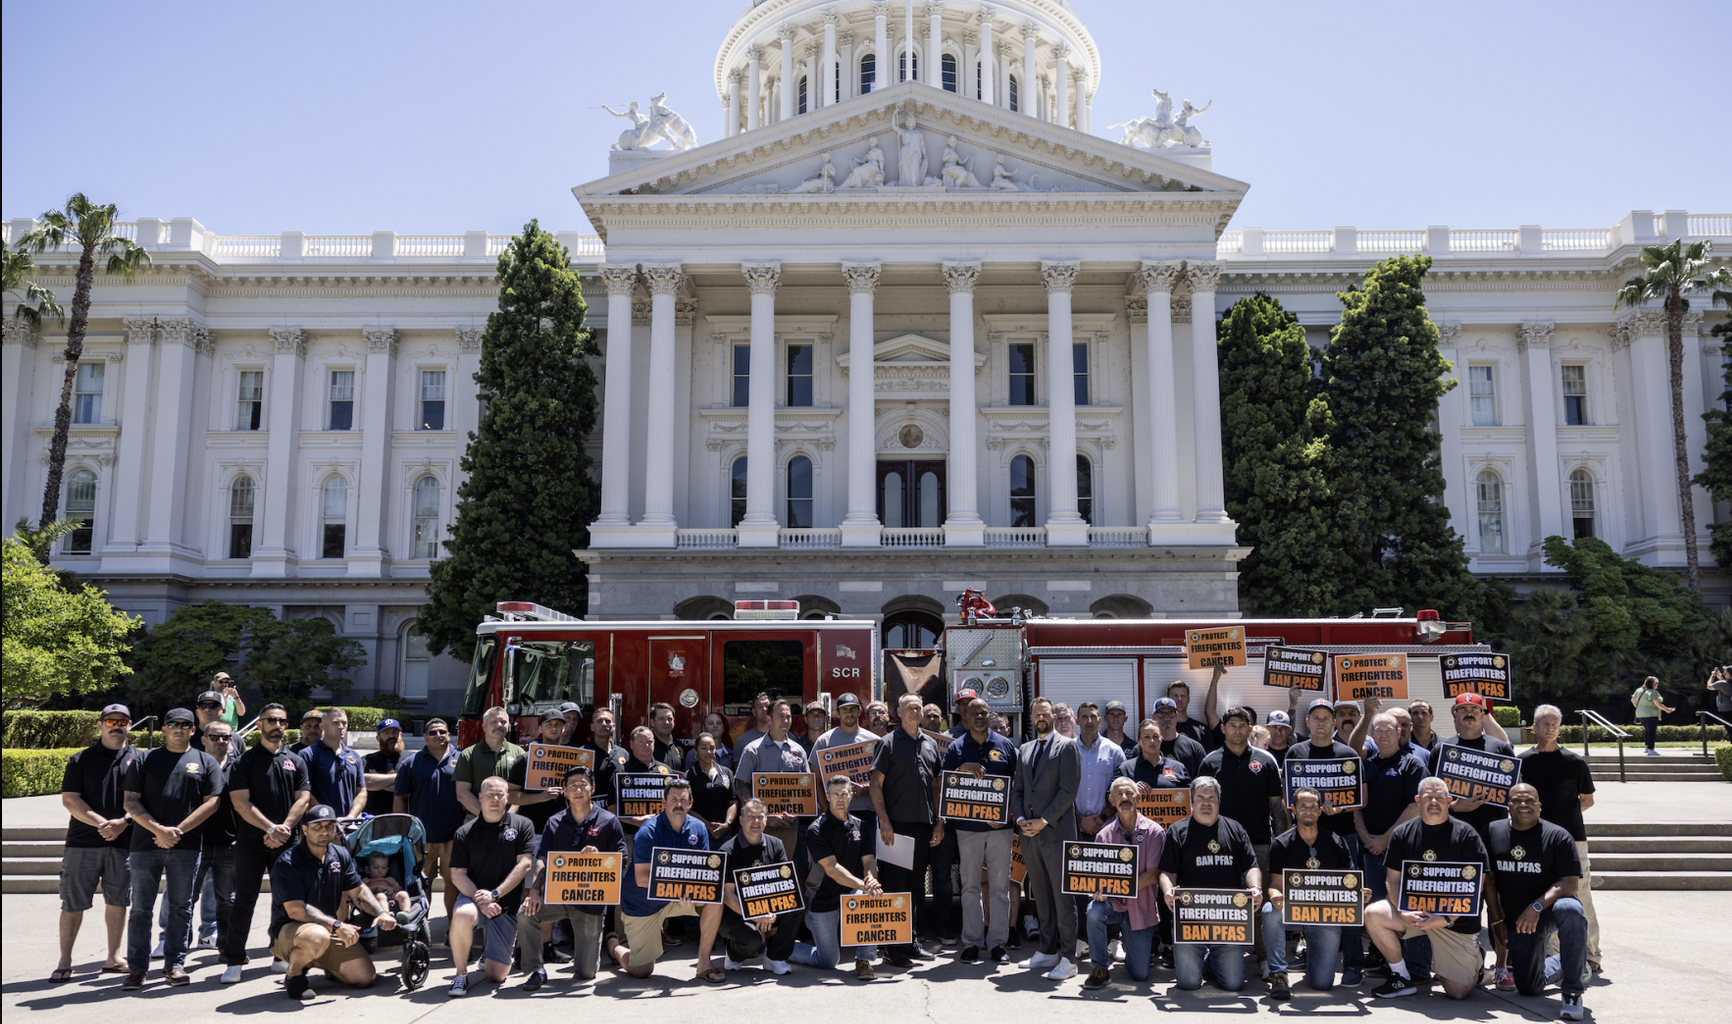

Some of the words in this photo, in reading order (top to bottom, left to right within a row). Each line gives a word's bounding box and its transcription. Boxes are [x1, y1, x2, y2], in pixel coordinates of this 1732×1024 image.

[1201, 632, 1228, 640] PROTECT
[1191, 642, 1241, 653] FIREFIGHTERS
[1201, 656, 1234, 667] CANCER
[1281, 651, 1311, 661] SUPPORT
[1458, 657, 1492, 665] SUPPORT
[1269, 661, 1322, 674] FIREFIGHTERS
[1354, 659, 1387, 667] PROTECT
[832, 667, 860, 678] SCR
[1341, 671, 1403, 682] FIREFIGHTERS
[1445, 668, 1506, 680] FIREFIGHTERS
[1269, 674, 1291, 686] BAN
[1293, 676, 1319, 689] PFAS
[1353, 687, 1393, 698] CANCER
[1449, 682, 1475, 696] BAN
[1478, 682, 1504, 697] PFAS
[548, 750, 578, 760] PROTECT
[835, 747, 864, 758] PROTECT
[825, 756, 872, 774] FIREFIGHTER
[1461, 753, 1500, 768] SUPPORT
[1305, 764, 1342, 773] SUPPORT
[1443, 762, 1512, 786] FIREFIGHTERS
[634, 778, 664, 786] SUPPORT
[960, 777, 992, 788] SUPPORT
[1292, 775, 1356, 787] FIREFIGHTERS
[758, 789, 812, 797] FIREFIGHTERS
[946, 788, 1004, 803] FIREFIGHTERS
[1444, 778, 1470, 796] BAN
[1472, 785, 1506, 803] PFAS
[1142, 794, 1172, 802] PROTECT
[624, 803, 646, 815] BAN
[768, 804, 804, 813] CANCER
[947, 803, 970, 817] BAN
[972, 805, 1000, 820] PFAS
[1137, 807, 1187, 816] EFIGHTERS
[1083, 848, 1119, 858] SUPPORT
[568, 858, 602, 866] PROTECT
[671, 854, 707, 865] SUPPORT
[1196, 855, 1213, 866] BAN
[1215, 855, 1233, 866] PFAS
[1068, 860, 1133, 875] FIREFIGHTERS
[1423, 867, 1461, 877] SUPPORT
[1497, 860, 1515, 871] BAN
[1517, 861, 1541, 873] PFAS
[552, 872, 615, 882] FIREFIGHTERS
[656, 866, 719, 881] FIREFIGHTERS
[751, 869, 780, 881] SUPPORT
[1070, 876, 1096, 892] BAN
[1099, 878, 1130, 894] PFAS
[1304, 876, 1342, 886] SUPPORT
[1407, 880, 1475, 893] FIREFIGHTERS
[656, 883, 682, 898] BAN
[685, 885, 716, 900] PFAS
[742, 879, 795, 898] FIREFIGHTERS
[562, 889, 604, 901] CANCER
[1194, 894, 1232, 904] SUPPORT
[1289, 889, 1358, 902] FIREFIGHTERS
[747, 899, 770, 916] BAN
[770, 894, 797, 912] PFAS
[860, 899, 892, 908] PROTECT
[1408, 896, 1436, 911] BAN
[1439, 898, 1471, 912] PFAS
[846, 912, 906, 924] FIREFIGHTERS
[1180, 908, 1248, 920] FIREFIGHTERS
[1292, 907, 1319, 922] BAN
[1323, 907, 1355, 922] PFAS
[857, 930, 896, 942] CANCER
[1183, 925, 1209, 940] BAN
[1213, 926, 1245, 941] PFAS
